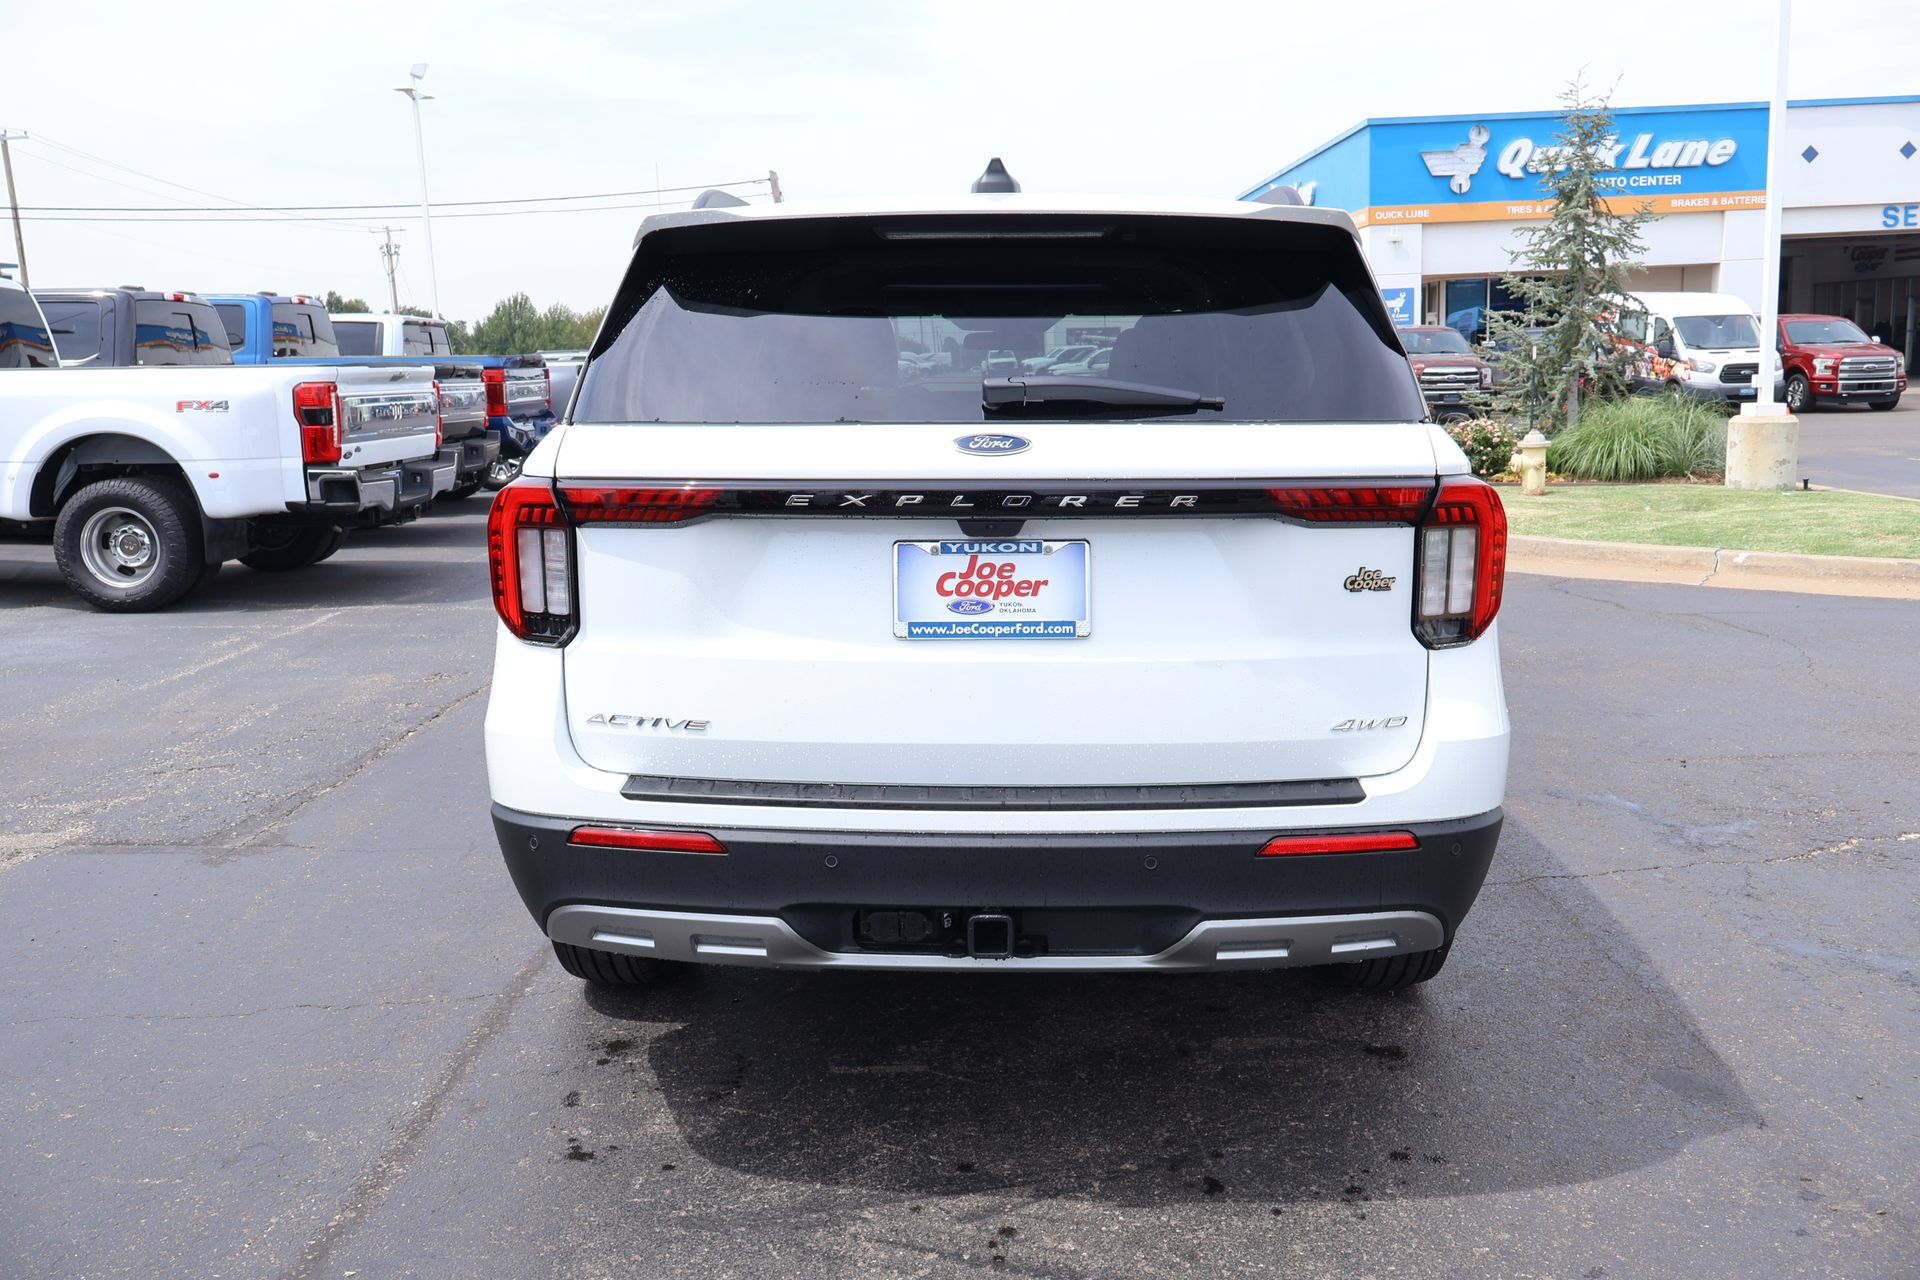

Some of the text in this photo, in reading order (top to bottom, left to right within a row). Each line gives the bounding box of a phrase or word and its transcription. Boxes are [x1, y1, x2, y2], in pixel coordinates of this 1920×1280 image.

[1622, 133, 1738, 168] Lane
[1630, 175, 1682, 187] CENTER
[1671, 198, 1709, 208] BRAKES
[1711, 197, 1718, 206] &
[1375, 211, 1403, 220] QUICK
[1406, 210, 1430, 218] LUBE
[1506, 205, 1532, 215] TIRES
[176, 400, 230, 413] FX4
[969, 435, 1014, 449] Ford
[784, 494, 1199, 507] EXPLORER
[946, 541, 1038, 553] YUKON
[958, 555, 1016, 579] Joe
[1356, 567, 1382, 581] Joe
[935, 572, 1048, 600] Cooper
[1344, 575, 1396, 590] Cooper
[959, 601, 983, 611] Ford
[911, 623, 1074, 637] www.JoeCooperFord.com
[586, 713, 711, 730] ACTIVE
[1331, 716, 1408, 731] 4WD
